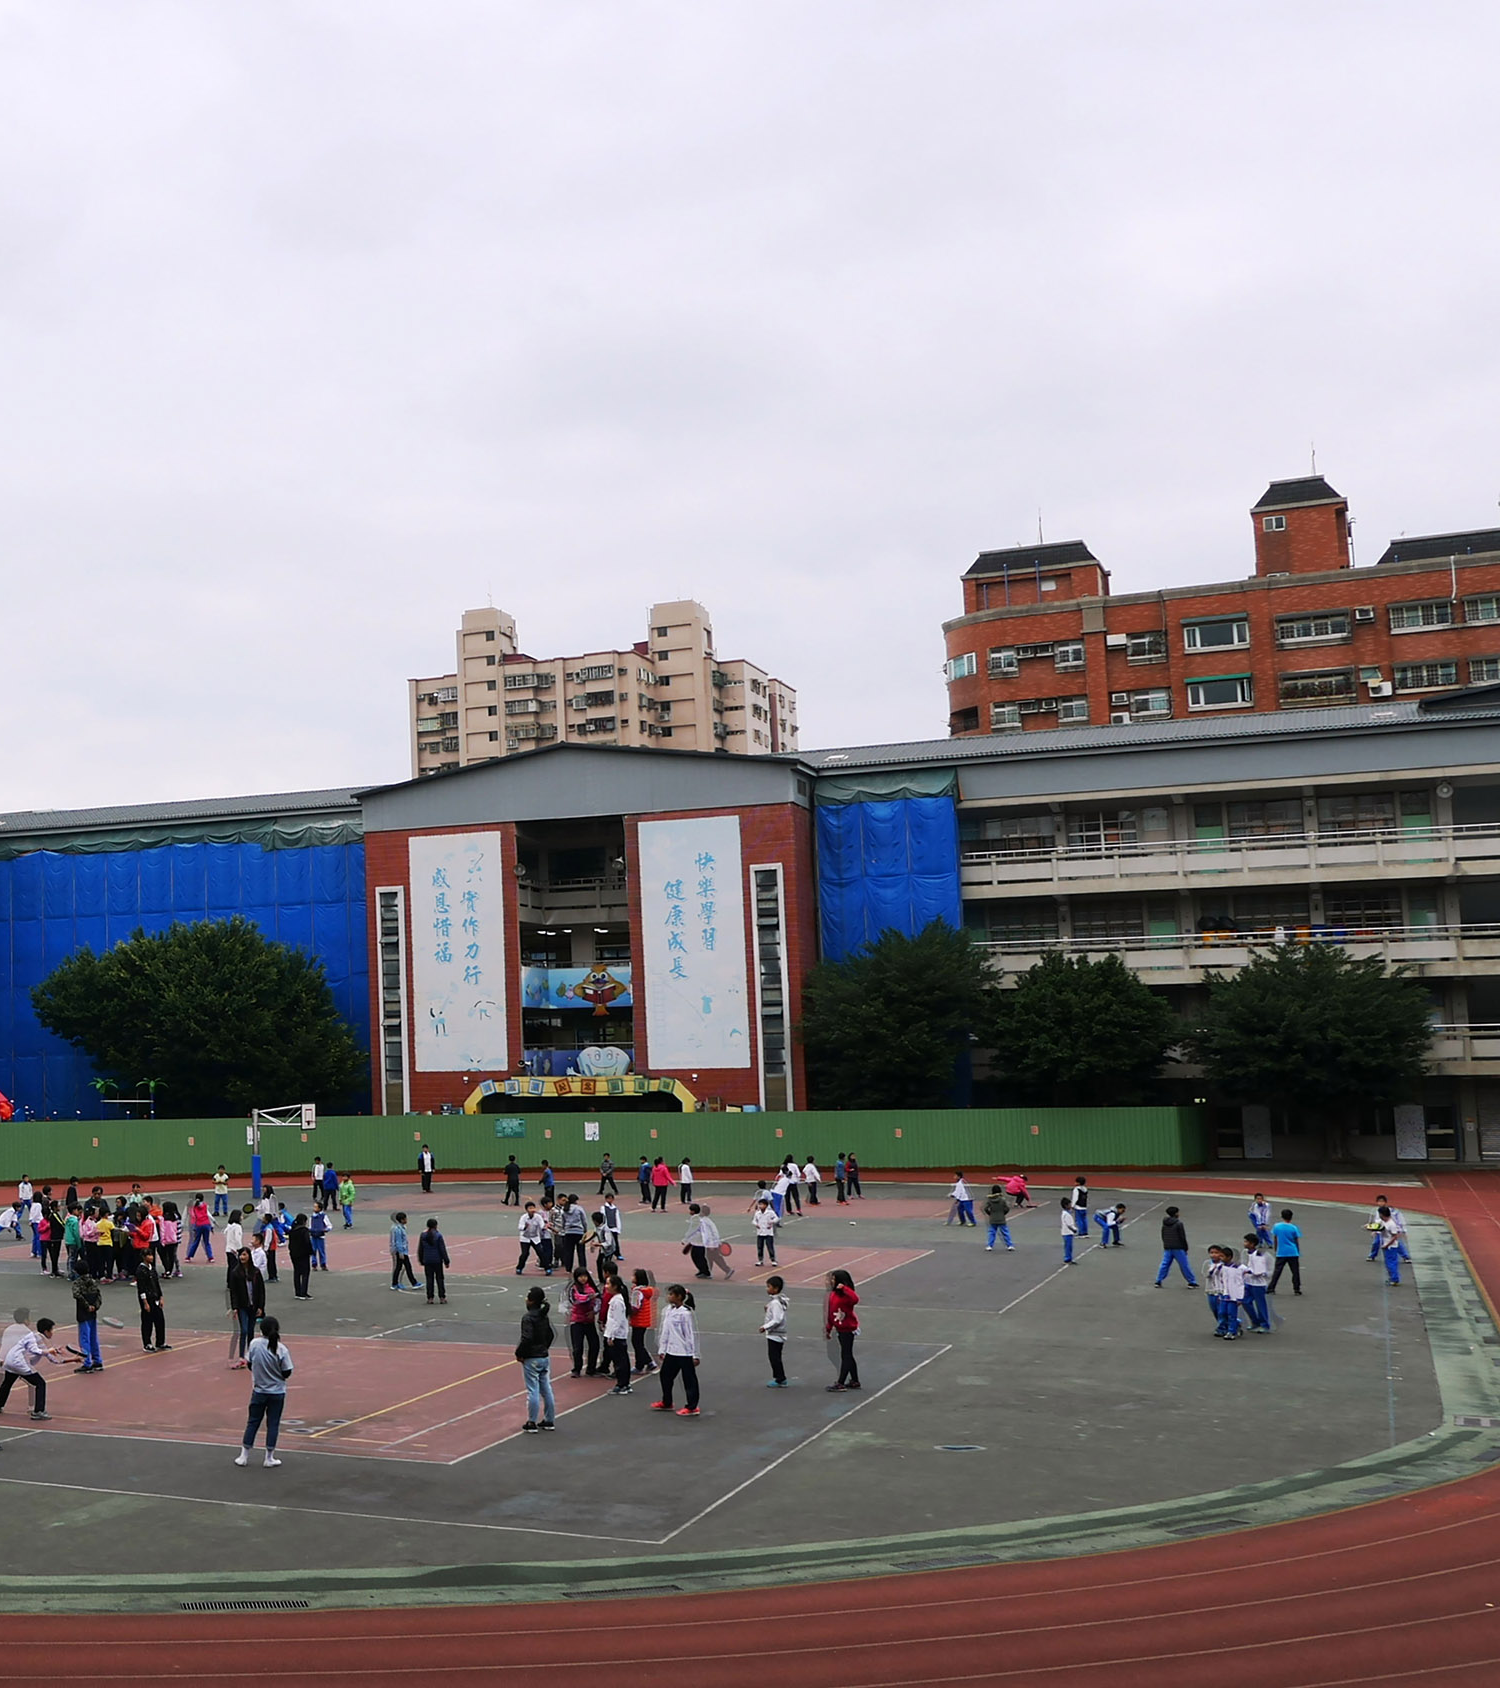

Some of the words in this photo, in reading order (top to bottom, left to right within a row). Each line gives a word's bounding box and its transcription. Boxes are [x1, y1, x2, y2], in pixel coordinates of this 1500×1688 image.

[432, 867, 452, 963] 感恩惜福
[663, 879, 688, 979] 健康成長
[695, 852, 716, 951] 快樂學習
